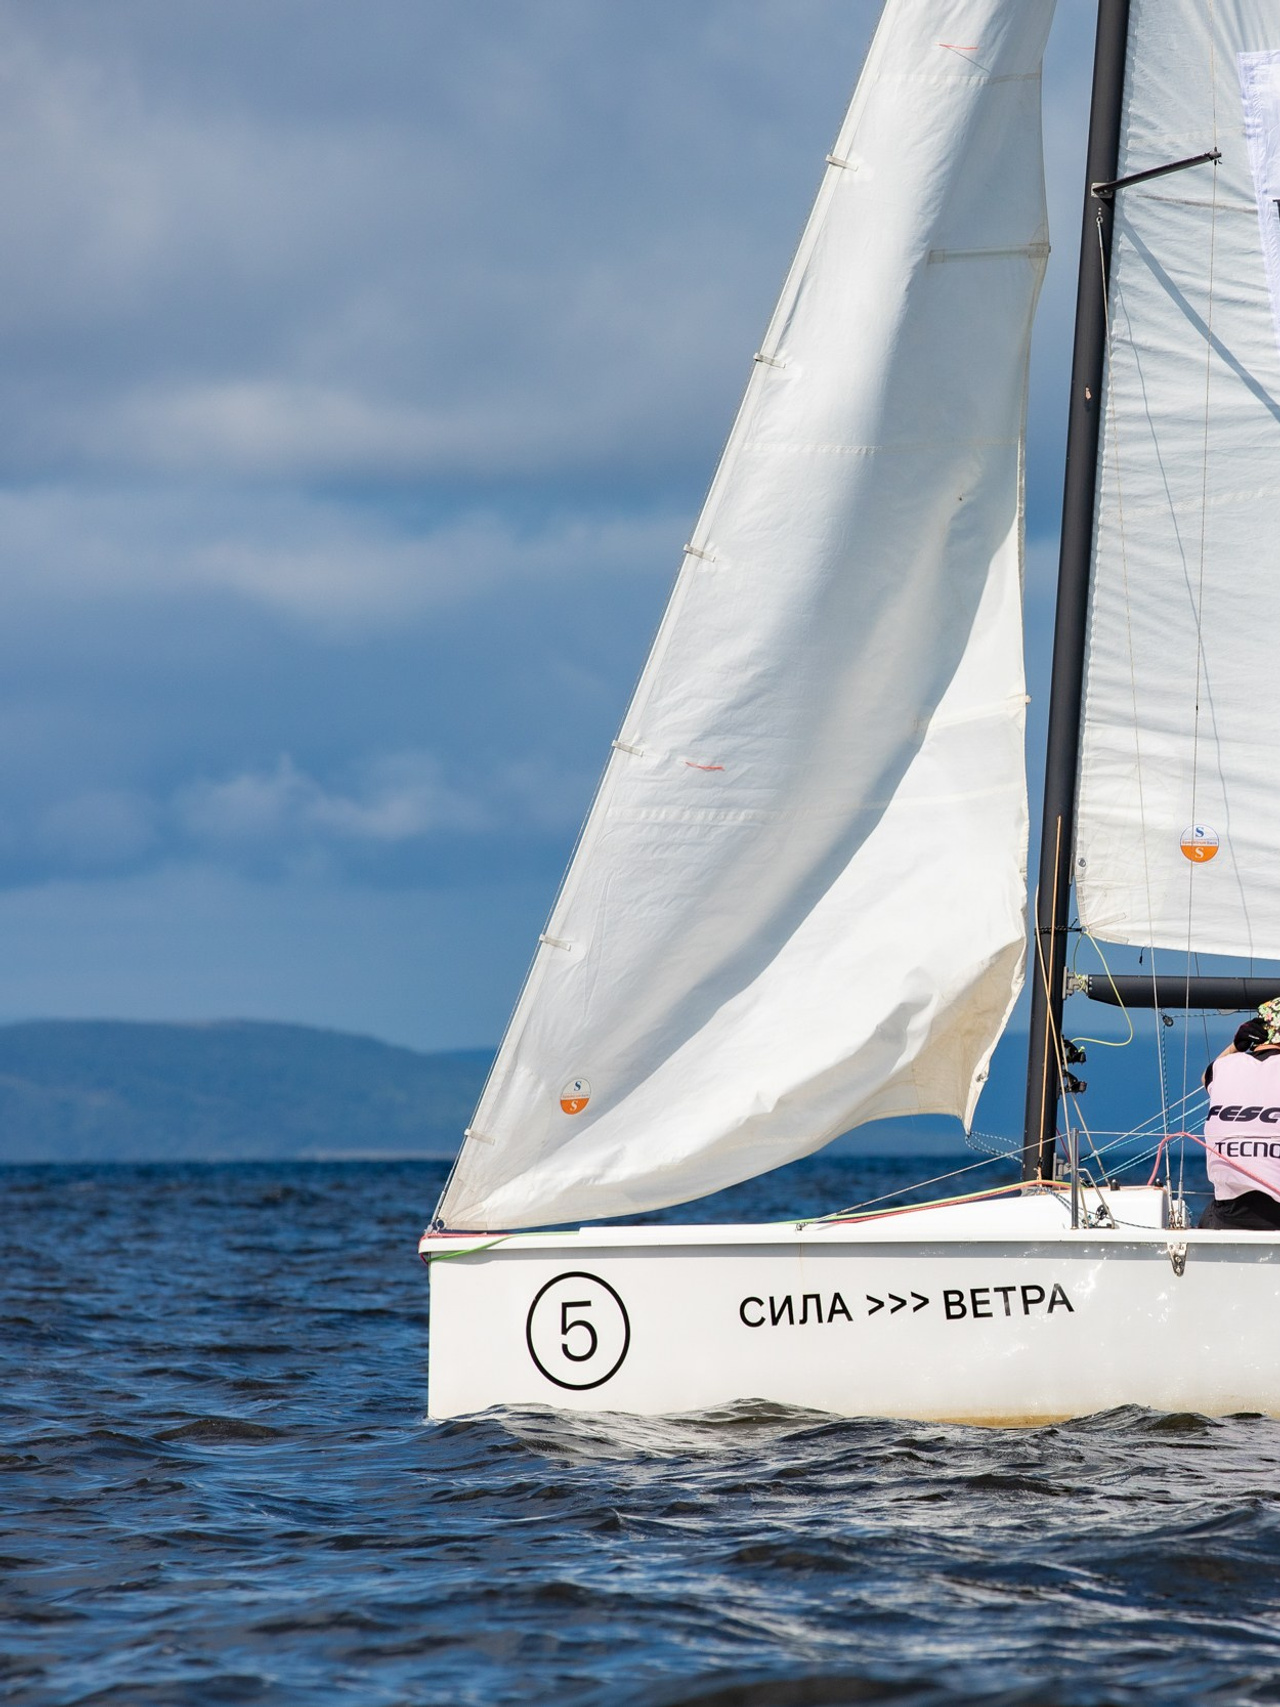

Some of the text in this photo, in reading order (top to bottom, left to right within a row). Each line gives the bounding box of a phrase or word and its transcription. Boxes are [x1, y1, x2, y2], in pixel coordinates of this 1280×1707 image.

[560, 1300, 599, 1363] 5
[738, 1291, 854, 1327] СИЛА
[943, 1282, 1076, 1321] ВЕТРА
